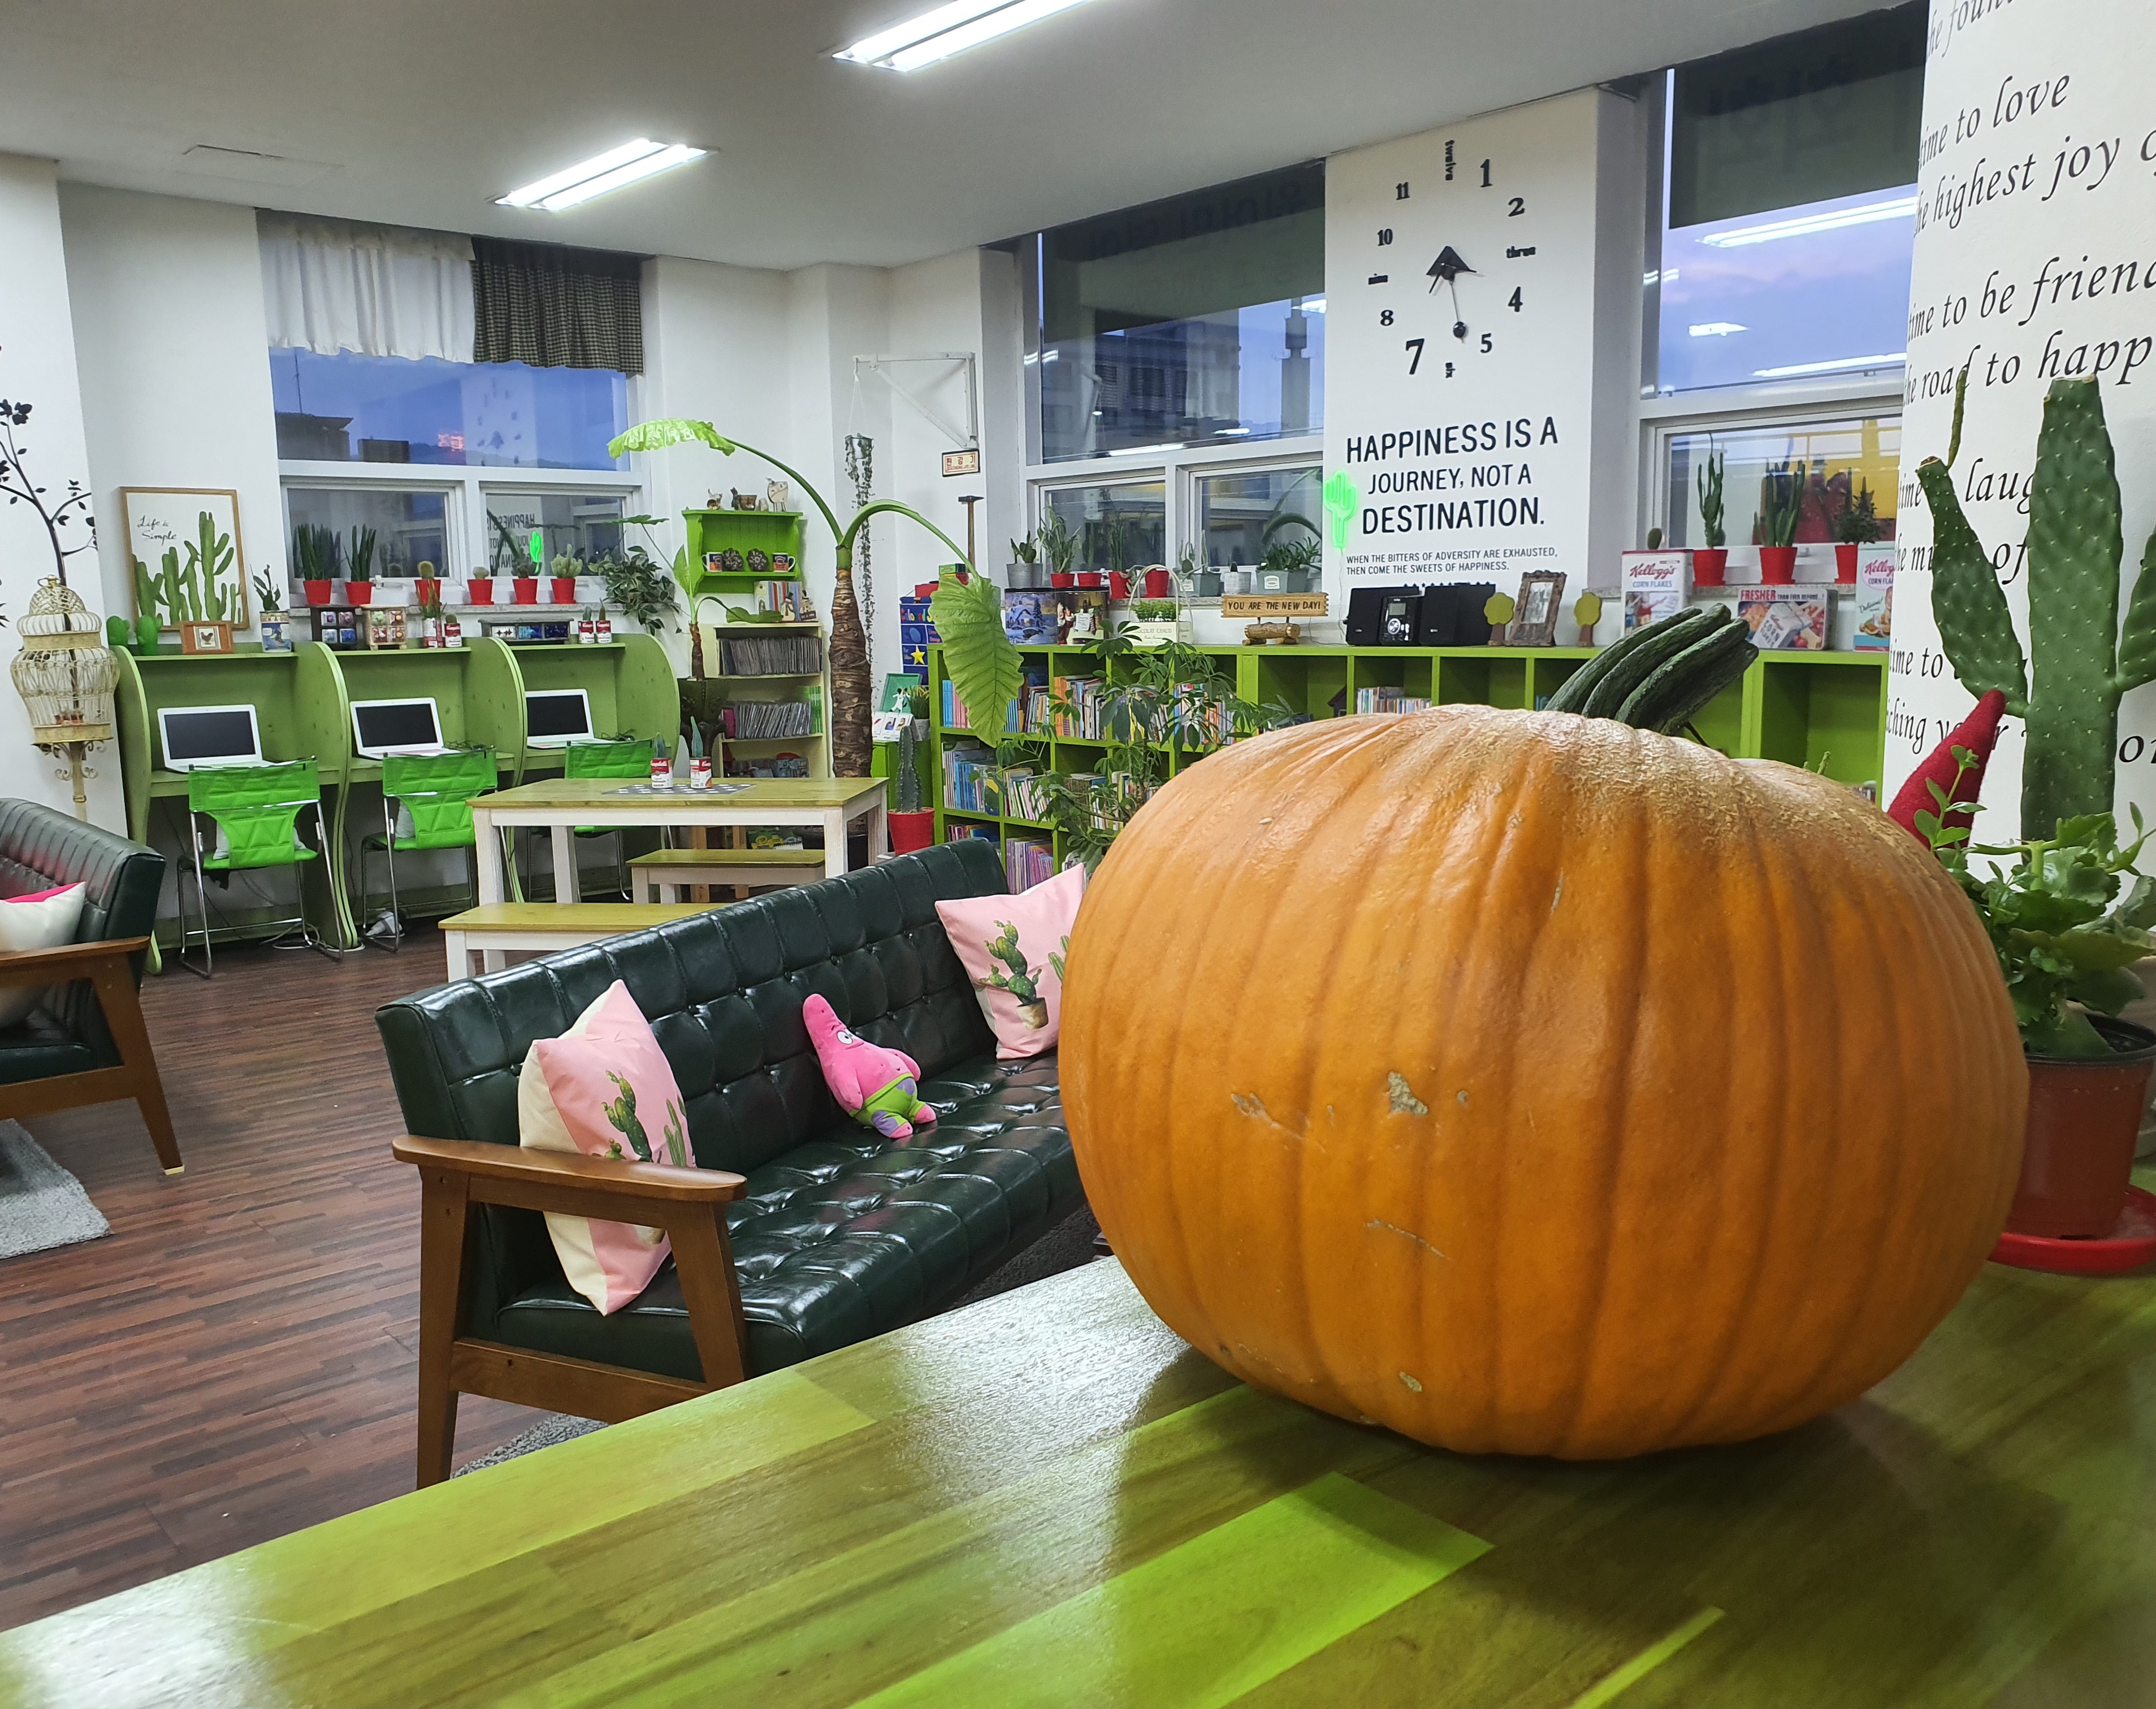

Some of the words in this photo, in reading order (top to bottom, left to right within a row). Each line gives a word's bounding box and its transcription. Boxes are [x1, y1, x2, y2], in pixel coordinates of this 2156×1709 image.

[1955, 107, 1981, 145] to
[1993, 74, 2070, 128] love
[1480, 159, 1492, 188] 1
[1933, 152, 2037, 229] highest
[2041, 136, 2121, 202] joy
[1395, 181, 1410, 201] 11
[1508, 197, 1525, 217] 2
[1377, 228, 1393, 246] 10
[1508, 286, 1523, 313] 4
[1908, 302, 1935, 343] time
[1942, 294, 1967, 328] to
[1980, 270, 2016, 318] be
[1380, 309, 1394, 327] 8
[1480, 333, 1492, 354] 5
[1405, 338, 1425, 375] 7
[1986, 353, 2020, 387] to
[1347, 422, 1497, 463] HAPPINESS
[1506, 418, 1531, 449] IS
[1540, 416, 1558, 445] A
[1368, 467, 1464, 495] JOURNEY,
[1471, 464, 1513, 488] NOT
[1517, 463, 1531, 485] A
[137, 515, 161, 530] Life
[1363, 497, 1544, 535] DESTINATION.
[142, 530, 177, 546] Simple
[1347, 555, 1369, 564] WHEN
[1371, 554, 1386, 563] THE
[1388, 552, 1420, 562] BITTERS
[1422, 552, 1434, 561] OF
[1435, 550, 1481, 560] ADVERSITY
[1483, 549, 1500, 559] ARE
[1503, 547, 1558, 558] EXHAUSTED,
[1347, 566, 1366, 575] THEN
[1368, 565, 1391, 575] COME
[1393, 565, 1408, 574] THE
[1410, 563, 1443, 573] SWEETS
[1445, 563, 1456, 571] OF
[1458, 561, 1509, 571] HAPPINESS.
[1629, 562, 1677, 580] Kellogg's
[1228, 601, 1244, 610] YOU
[1248, 601, 1261, 610] ARE
[1266, 601, 1280, 610] THE
[1282, 601, 1301, 610] NEW
[1741, 589, 1777, 601] FRESHER
[1922, 648, 1943, 678] to
